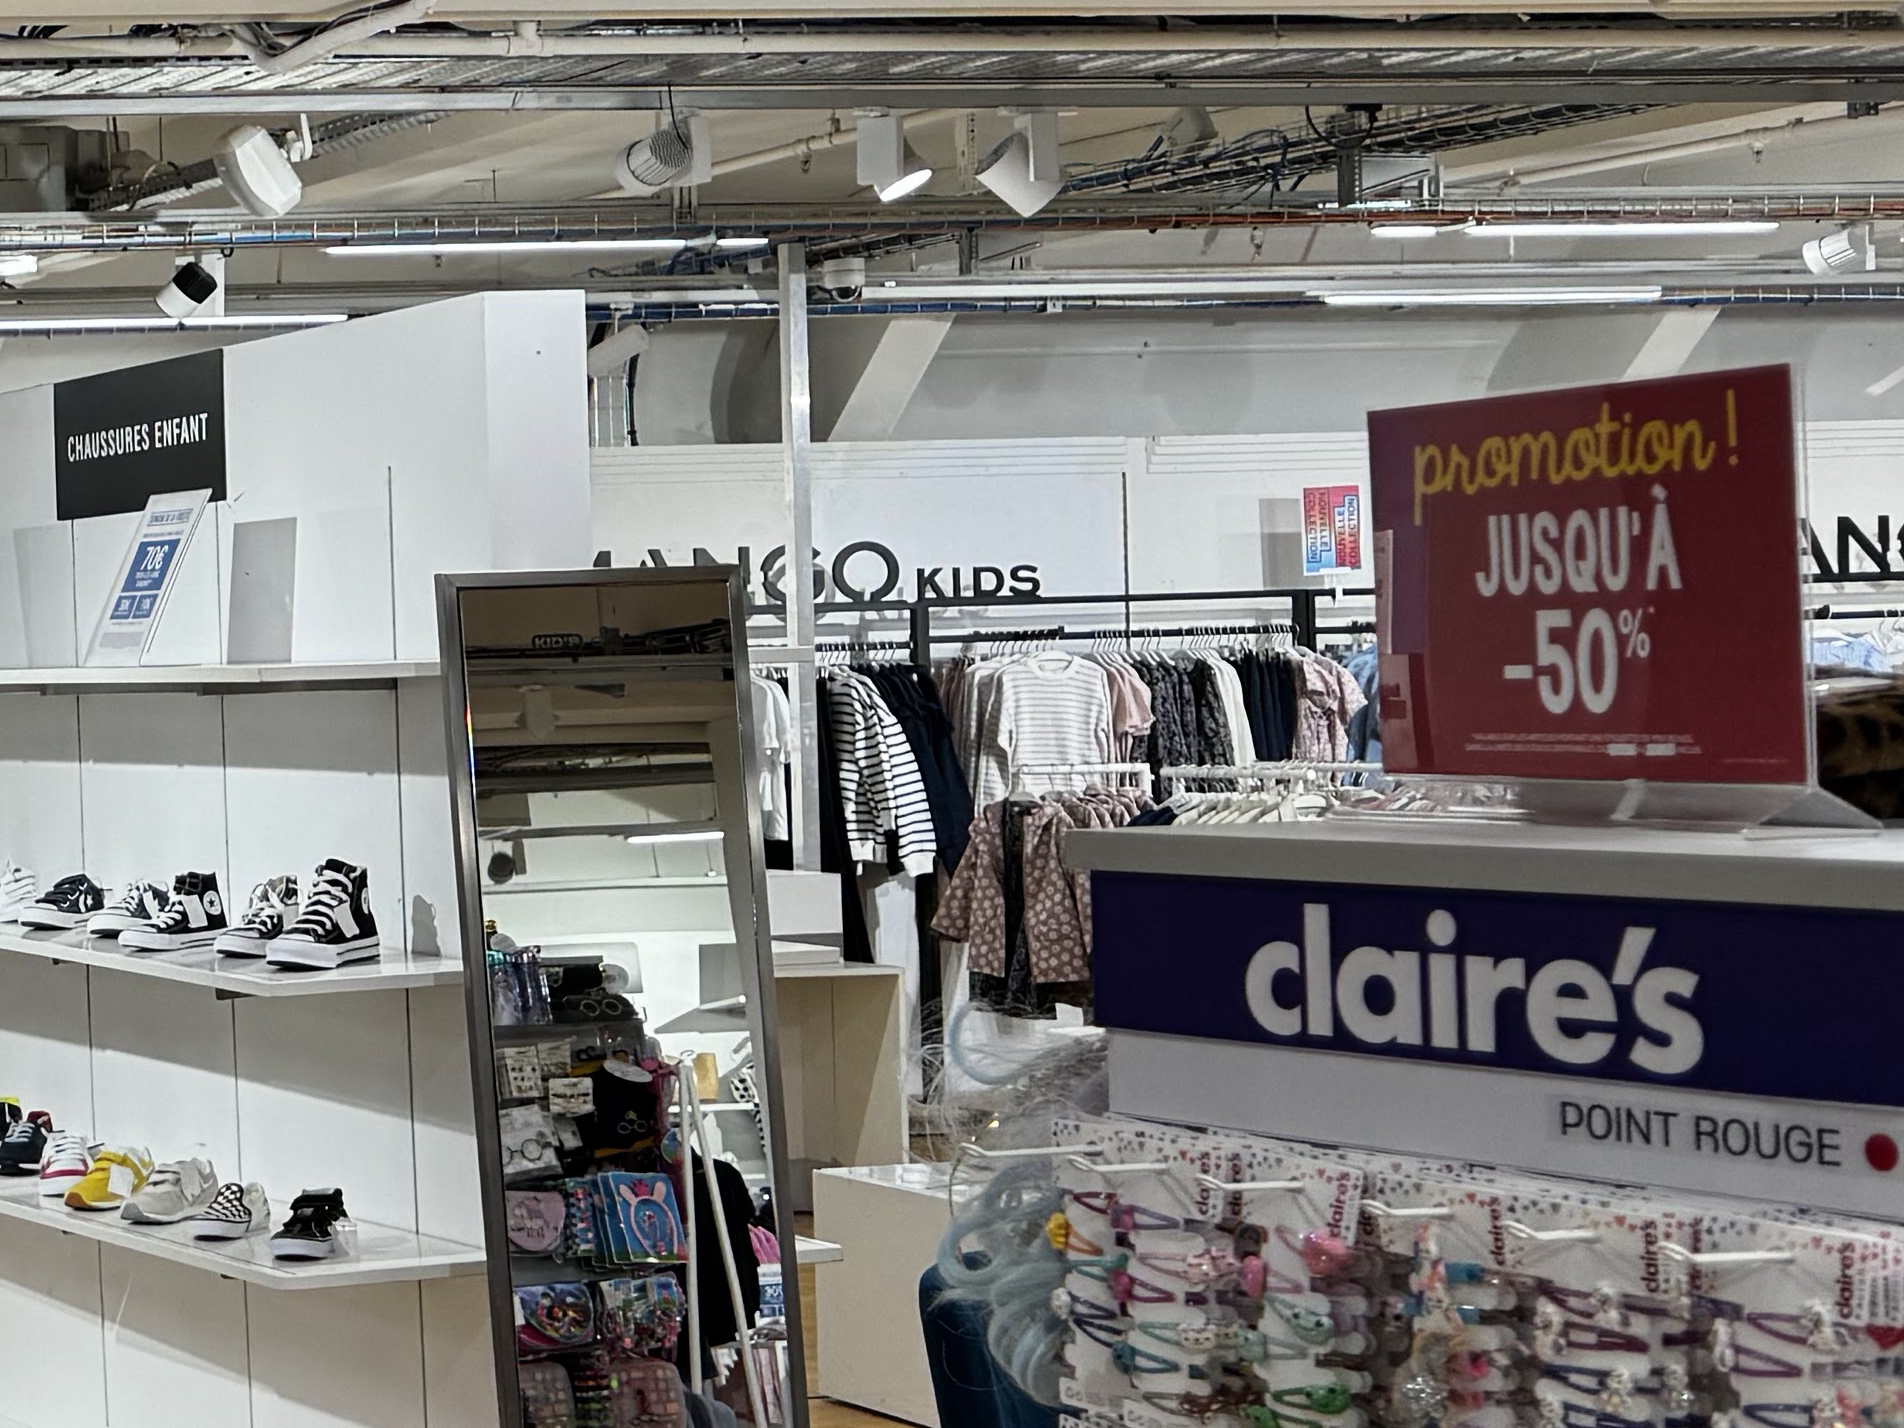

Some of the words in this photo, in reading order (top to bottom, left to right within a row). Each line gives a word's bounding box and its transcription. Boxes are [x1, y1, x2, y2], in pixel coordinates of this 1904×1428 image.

[67, 423, 150, 462] CHAUSSURES
[155, 412, 209, 448] ENFANT
[140, 545, 169, 570] 70€
[1476, 483, 1682, 597] JUSQU'À
[916, 565, 1041, 597] KIDS
[1245, 903, 1705, 1075] claire's
[1559, 1101, 1677, 1149] POINT
[1696, 1113, 1842, 1168] ROUGE
[1327, 1171, 1350, 1238] claire's
[1640, 1220, 1659, 1293] claire's
[1833, 1241, 1855, 1319] claire's
